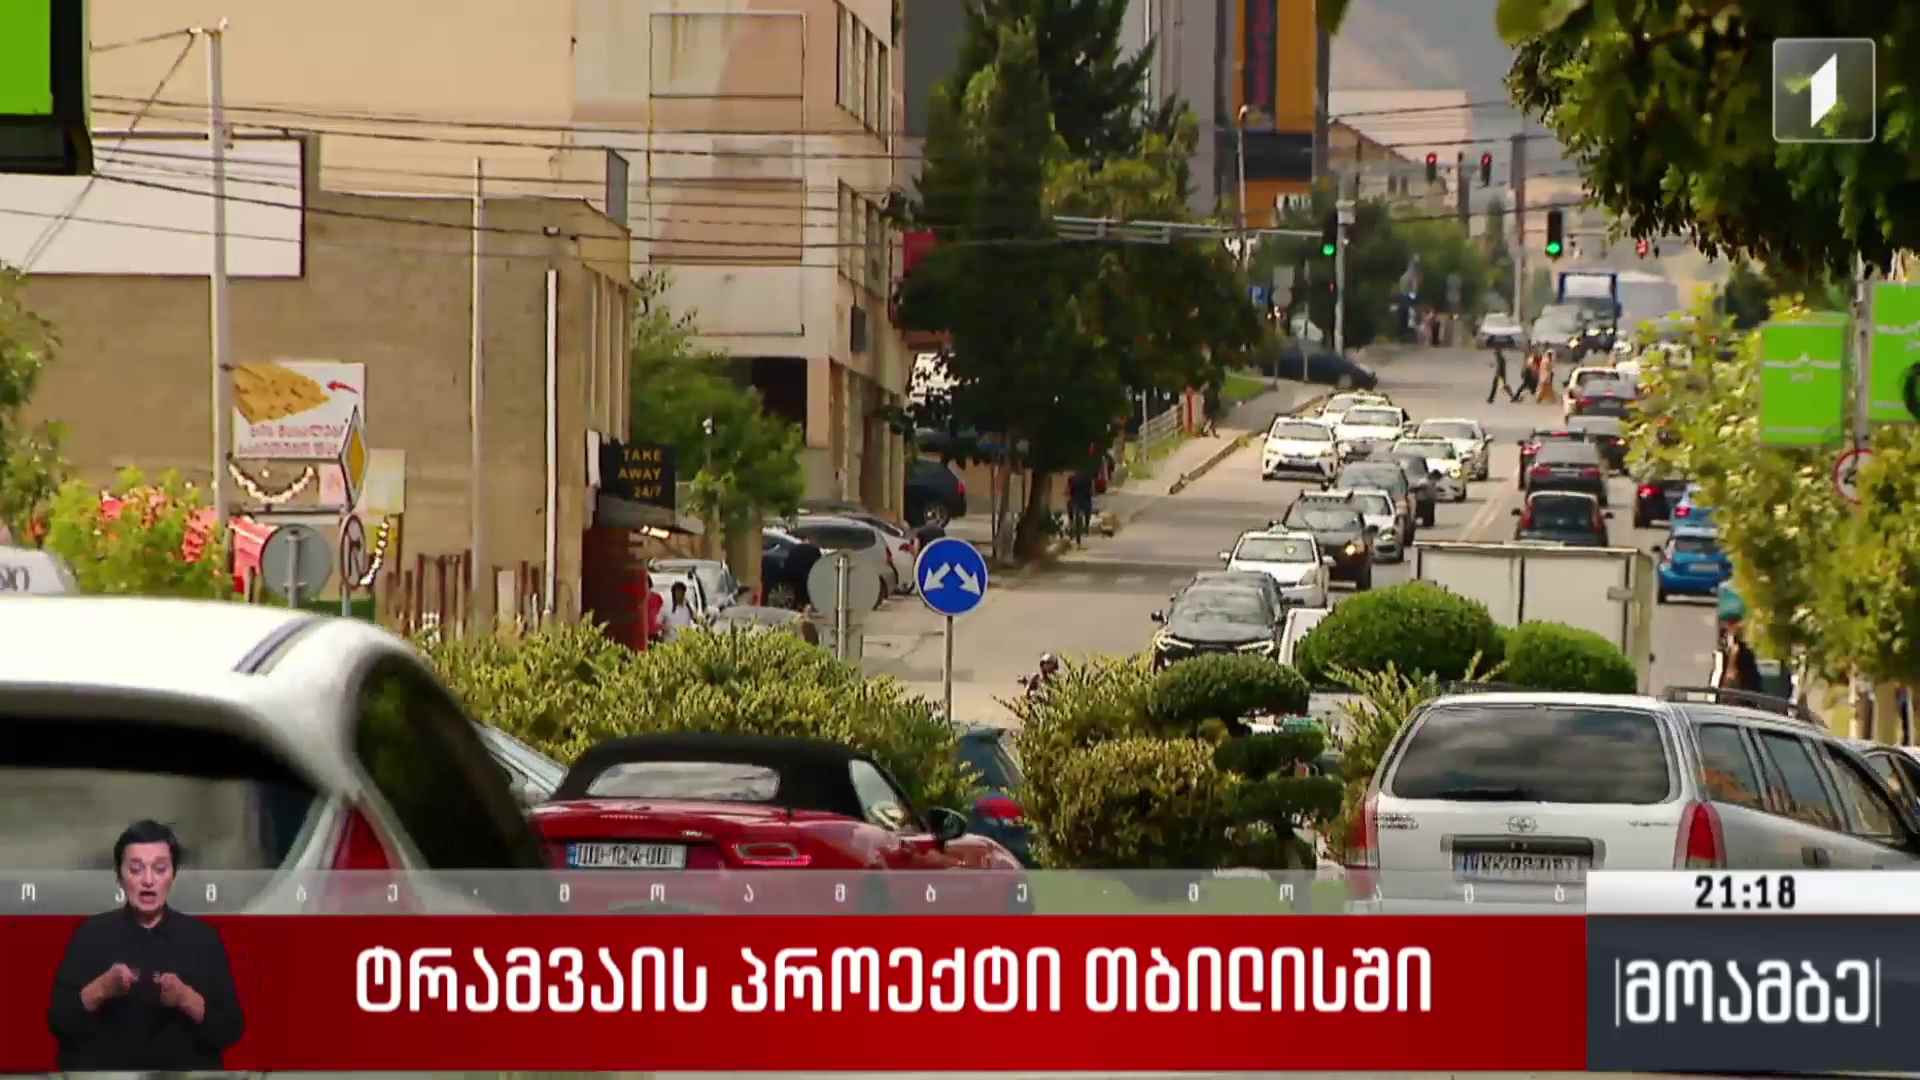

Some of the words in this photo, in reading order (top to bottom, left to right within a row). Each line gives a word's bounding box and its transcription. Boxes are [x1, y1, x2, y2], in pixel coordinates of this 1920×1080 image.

[623, 448, 663, 462] TAKE
[617, 467, 662, 481] AWAY
[633, 486, 662, 499] 24/7
